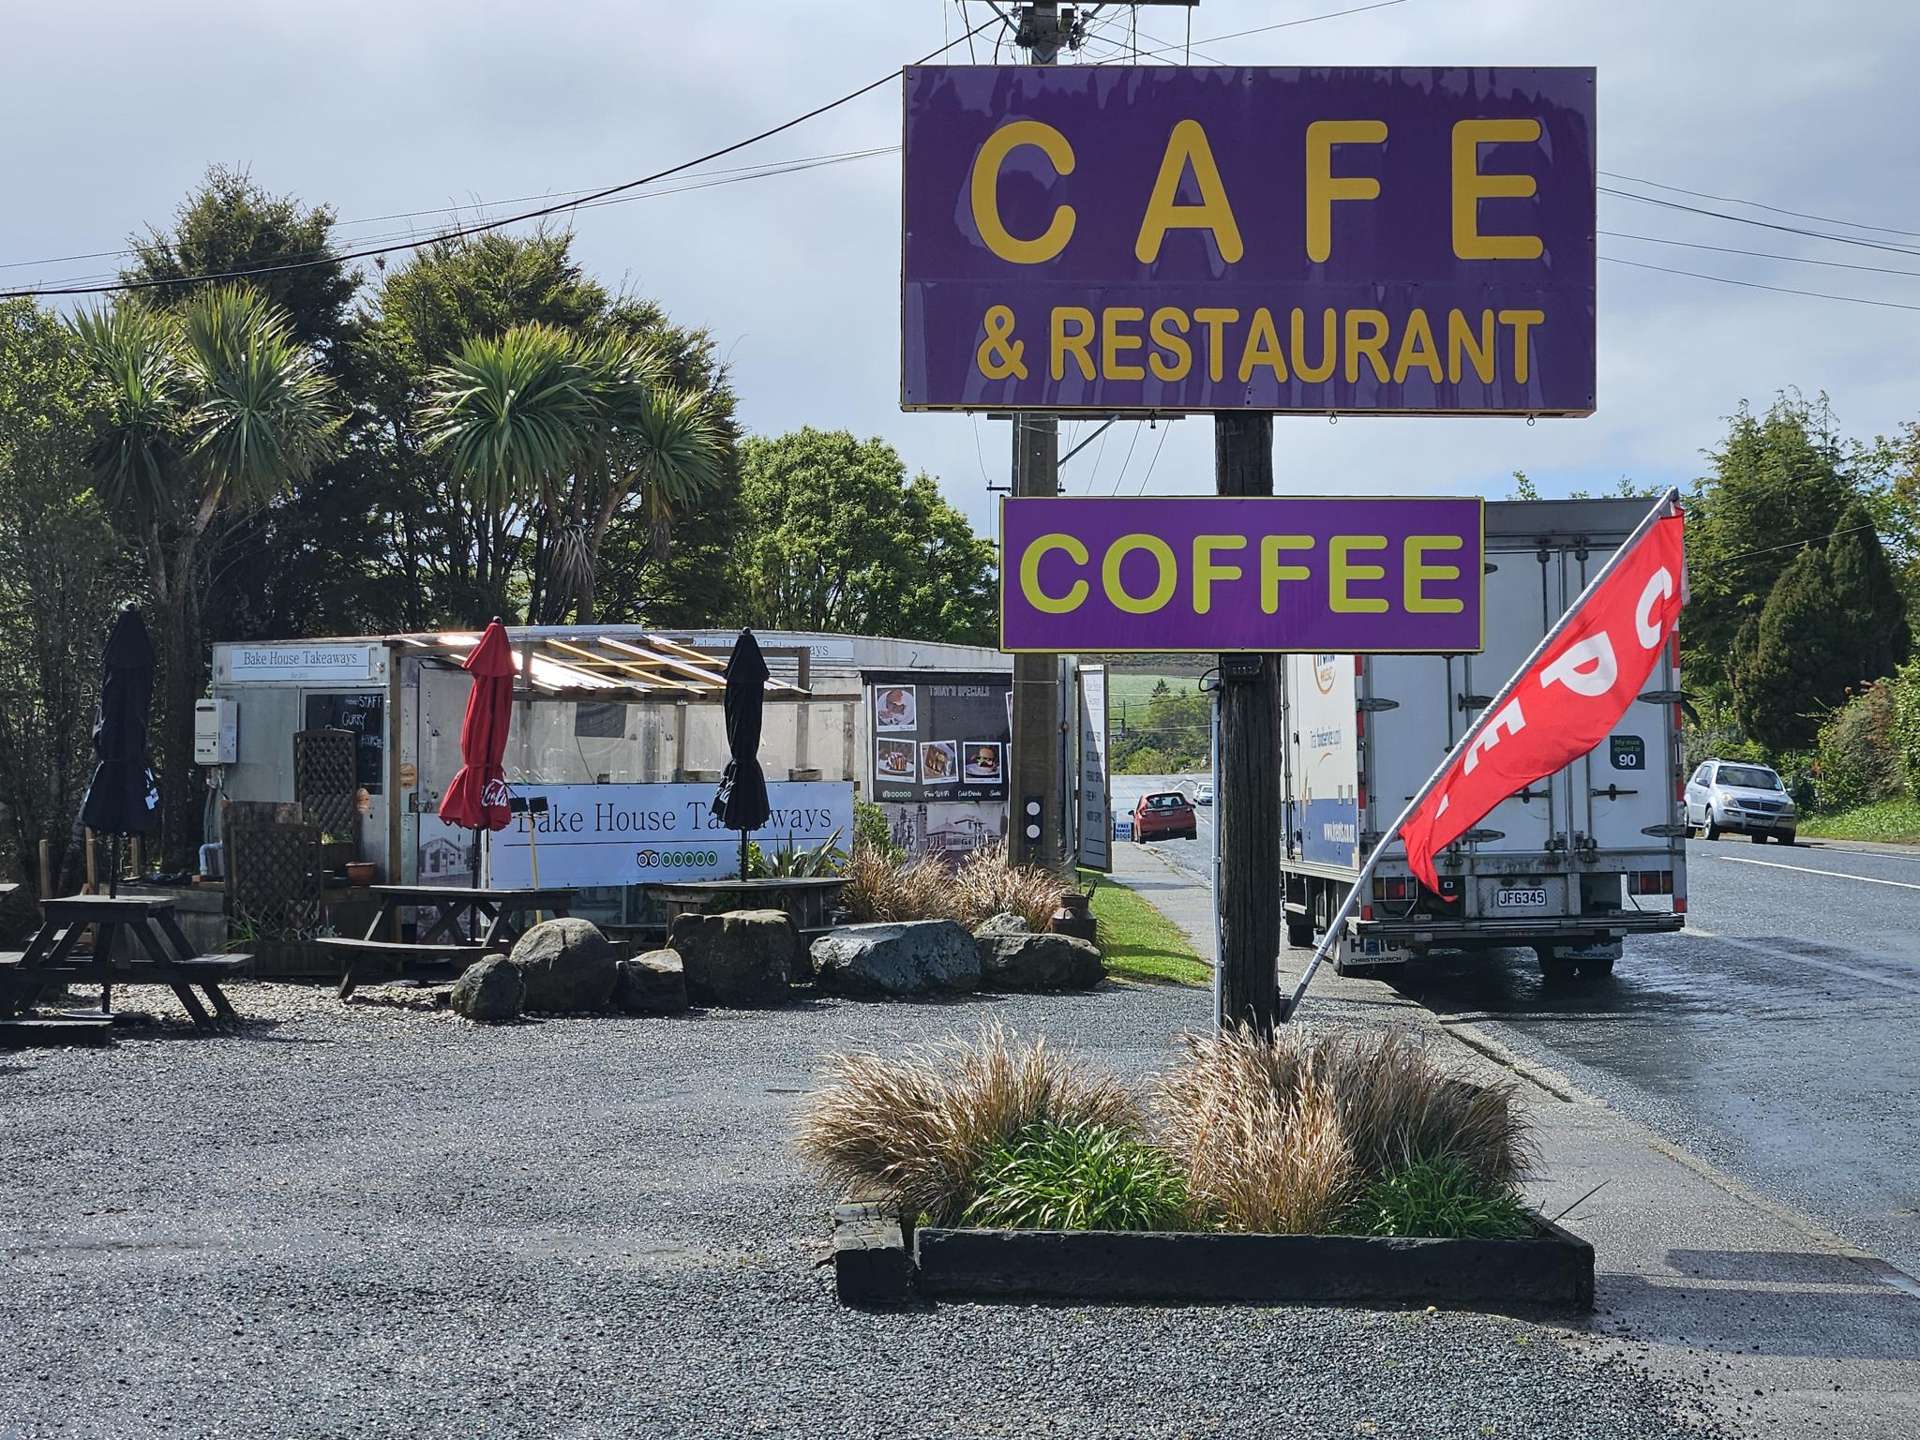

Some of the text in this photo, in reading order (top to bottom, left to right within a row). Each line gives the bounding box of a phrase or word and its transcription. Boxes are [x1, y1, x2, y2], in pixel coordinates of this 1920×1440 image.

[971, 119, 1544, 263] CAFE
[978, 304, 1546, 384] & RESTAURANT
[1020, 534, 1463, 614] COFFEE
[244, 650, 358, 666] Bake House Takeaways
[1435, 567, 1673, 820] OPE
[1619, 754, 1636, 766] 90
[594, 803, 676, 832] House
[687, 801, 832, 833] Taways
[1500, 892, 1545, 904] JFG345
